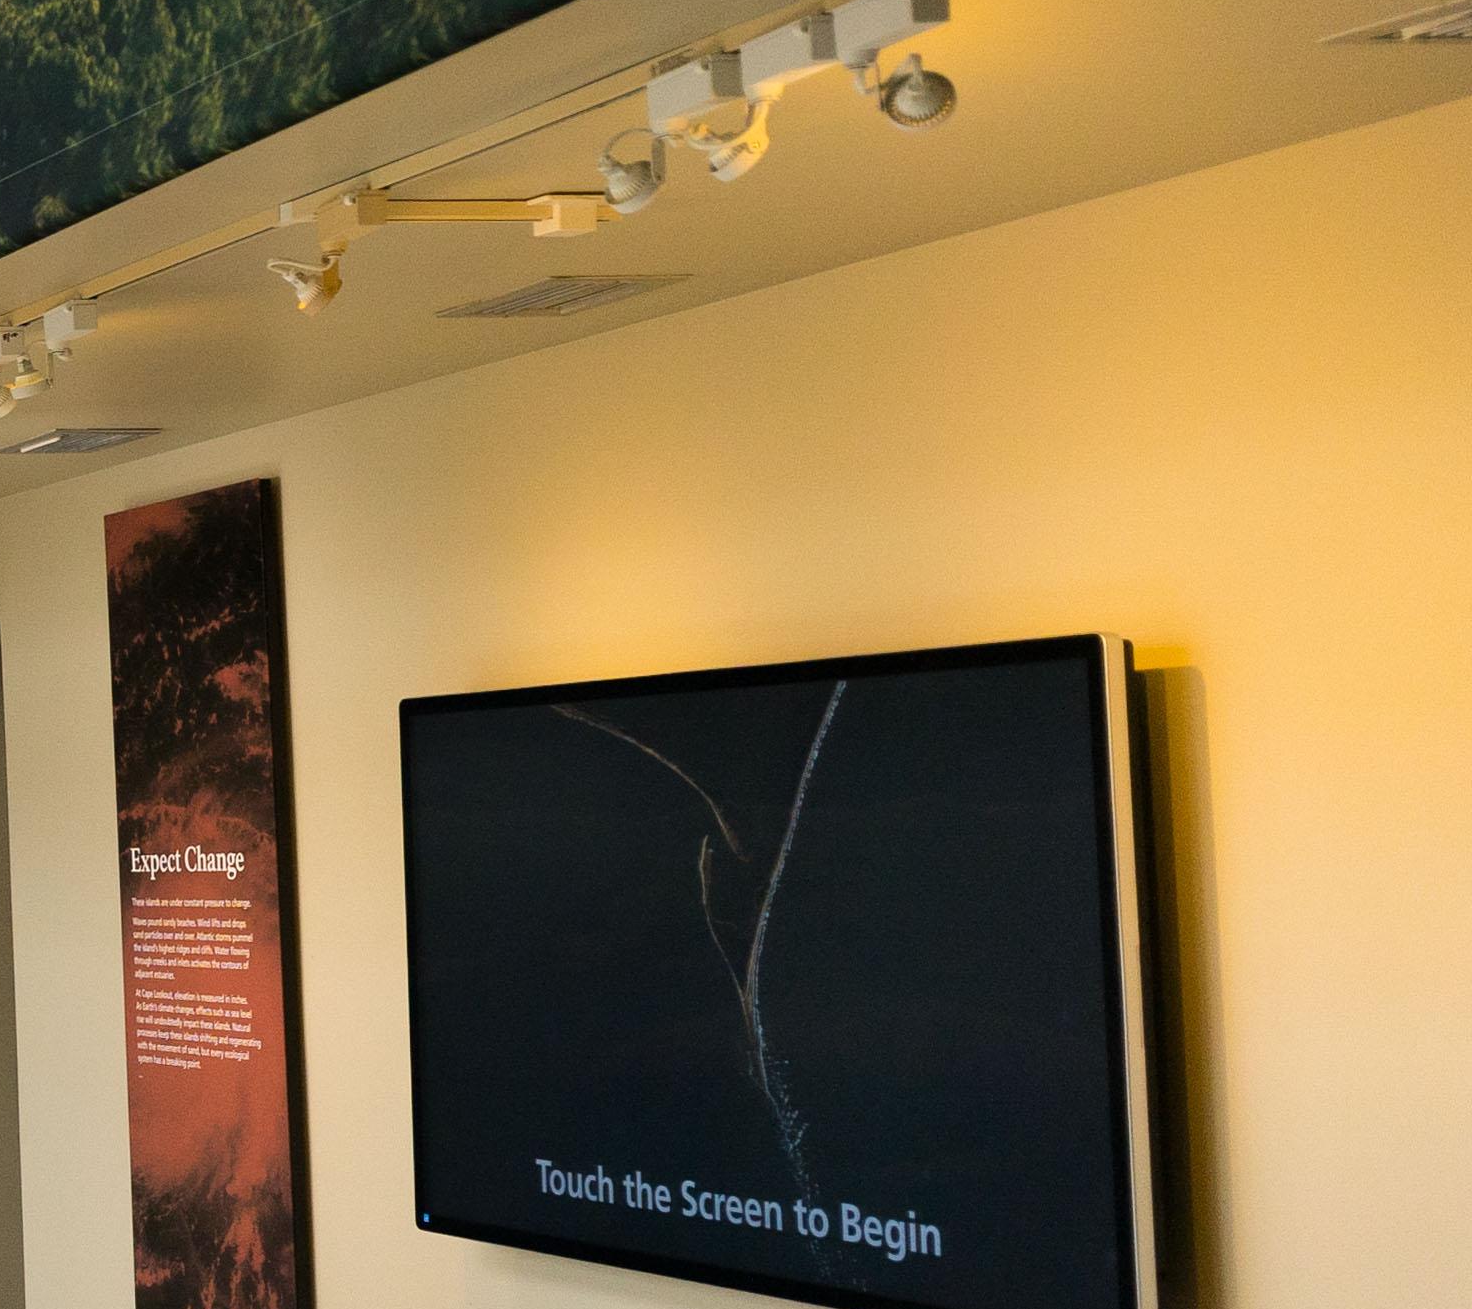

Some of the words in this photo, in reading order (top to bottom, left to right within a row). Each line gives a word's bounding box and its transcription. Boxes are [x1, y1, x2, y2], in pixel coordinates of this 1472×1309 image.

[130, 847, 182, 881] Expect
[184, 844, 245, 880] Change
[535, 1158, 614, 1206] Touch
[623, 1170, 672, 1214] the
[682, 1180, 784, 1232] Screen
[794, 1198, 830, 1239] to
[841, 1202, 942, 1263] Begin
